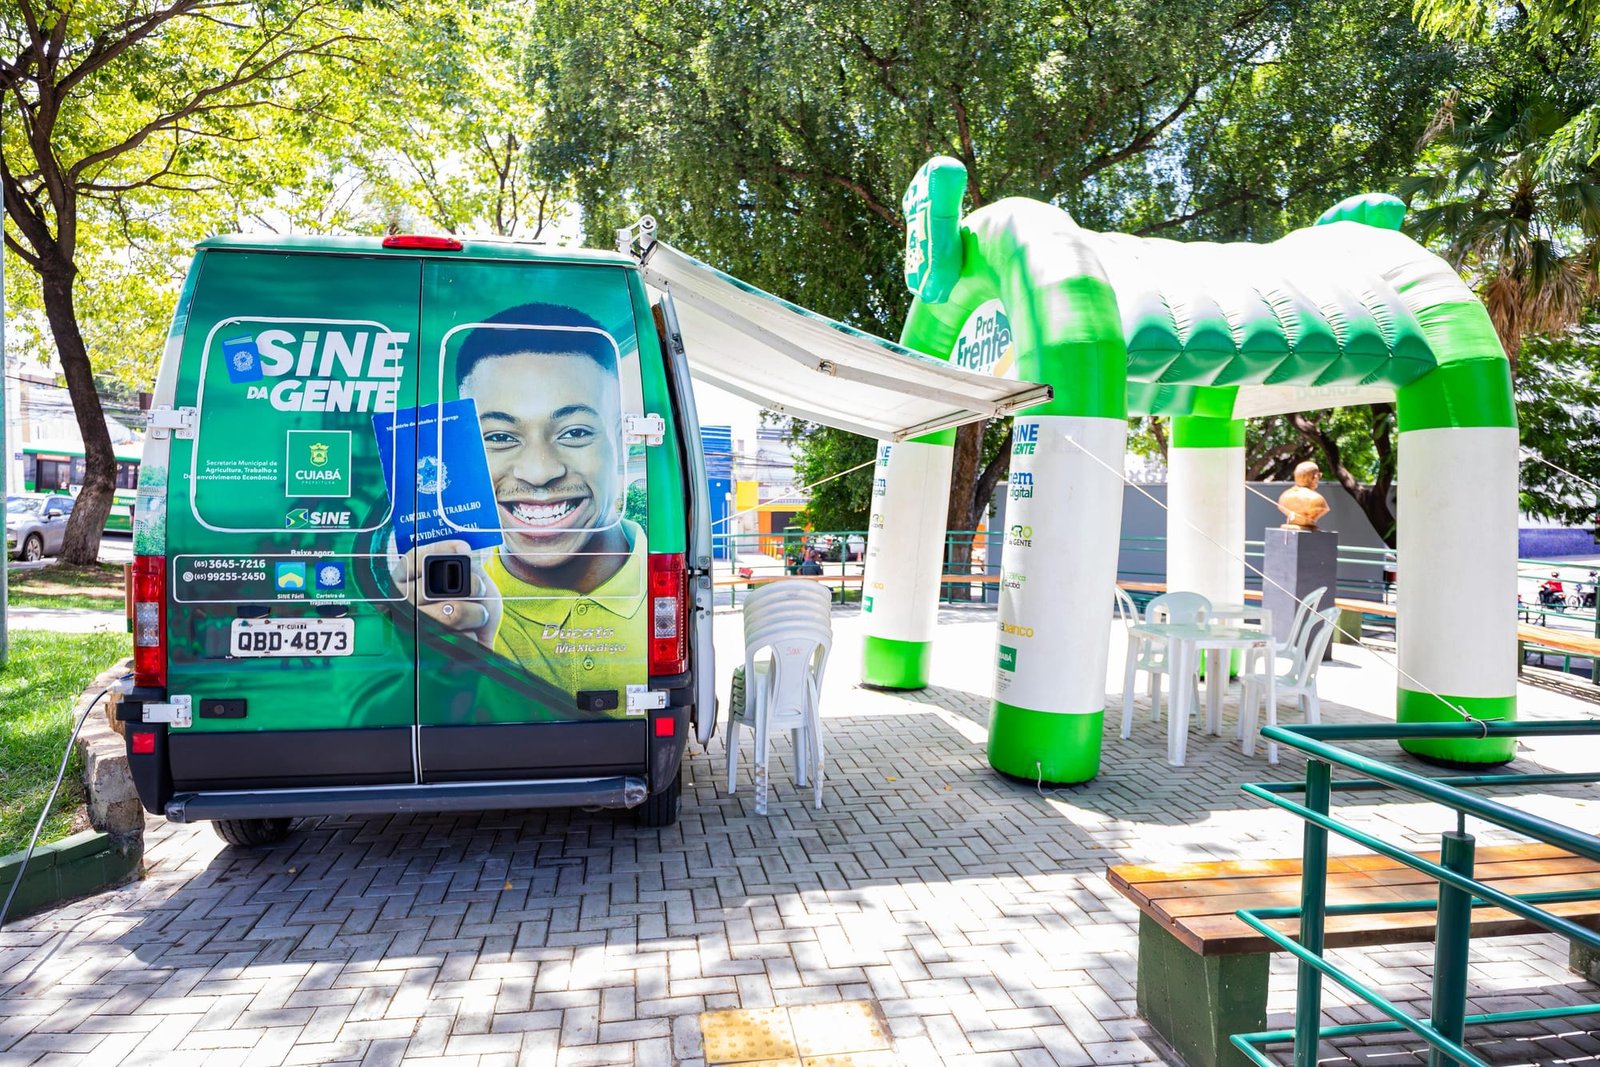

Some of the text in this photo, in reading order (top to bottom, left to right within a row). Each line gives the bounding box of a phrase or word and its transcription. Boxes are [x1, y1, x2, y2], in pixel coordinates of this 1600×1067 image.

[975, 315, 994, 339] Pra
[957, 326, 1010, 370] Frente
[247, 379, 401, 413] DA GENTE
[238, 460, 268, 468] Municipal
[242, 473, 278, 481] Econômico
[295, 468, 342, 480] CUIABÁ
[445, 501, 481, 515] TRABALHO
[309, 511, 351, 525] SINE
[208, 559, 266, 569] 3645-7216
[207, 572, 266, 581] 99255-2450
[541, 624, 614, 640] Ducato
[554, 641, 627, 654] Maxicargo
